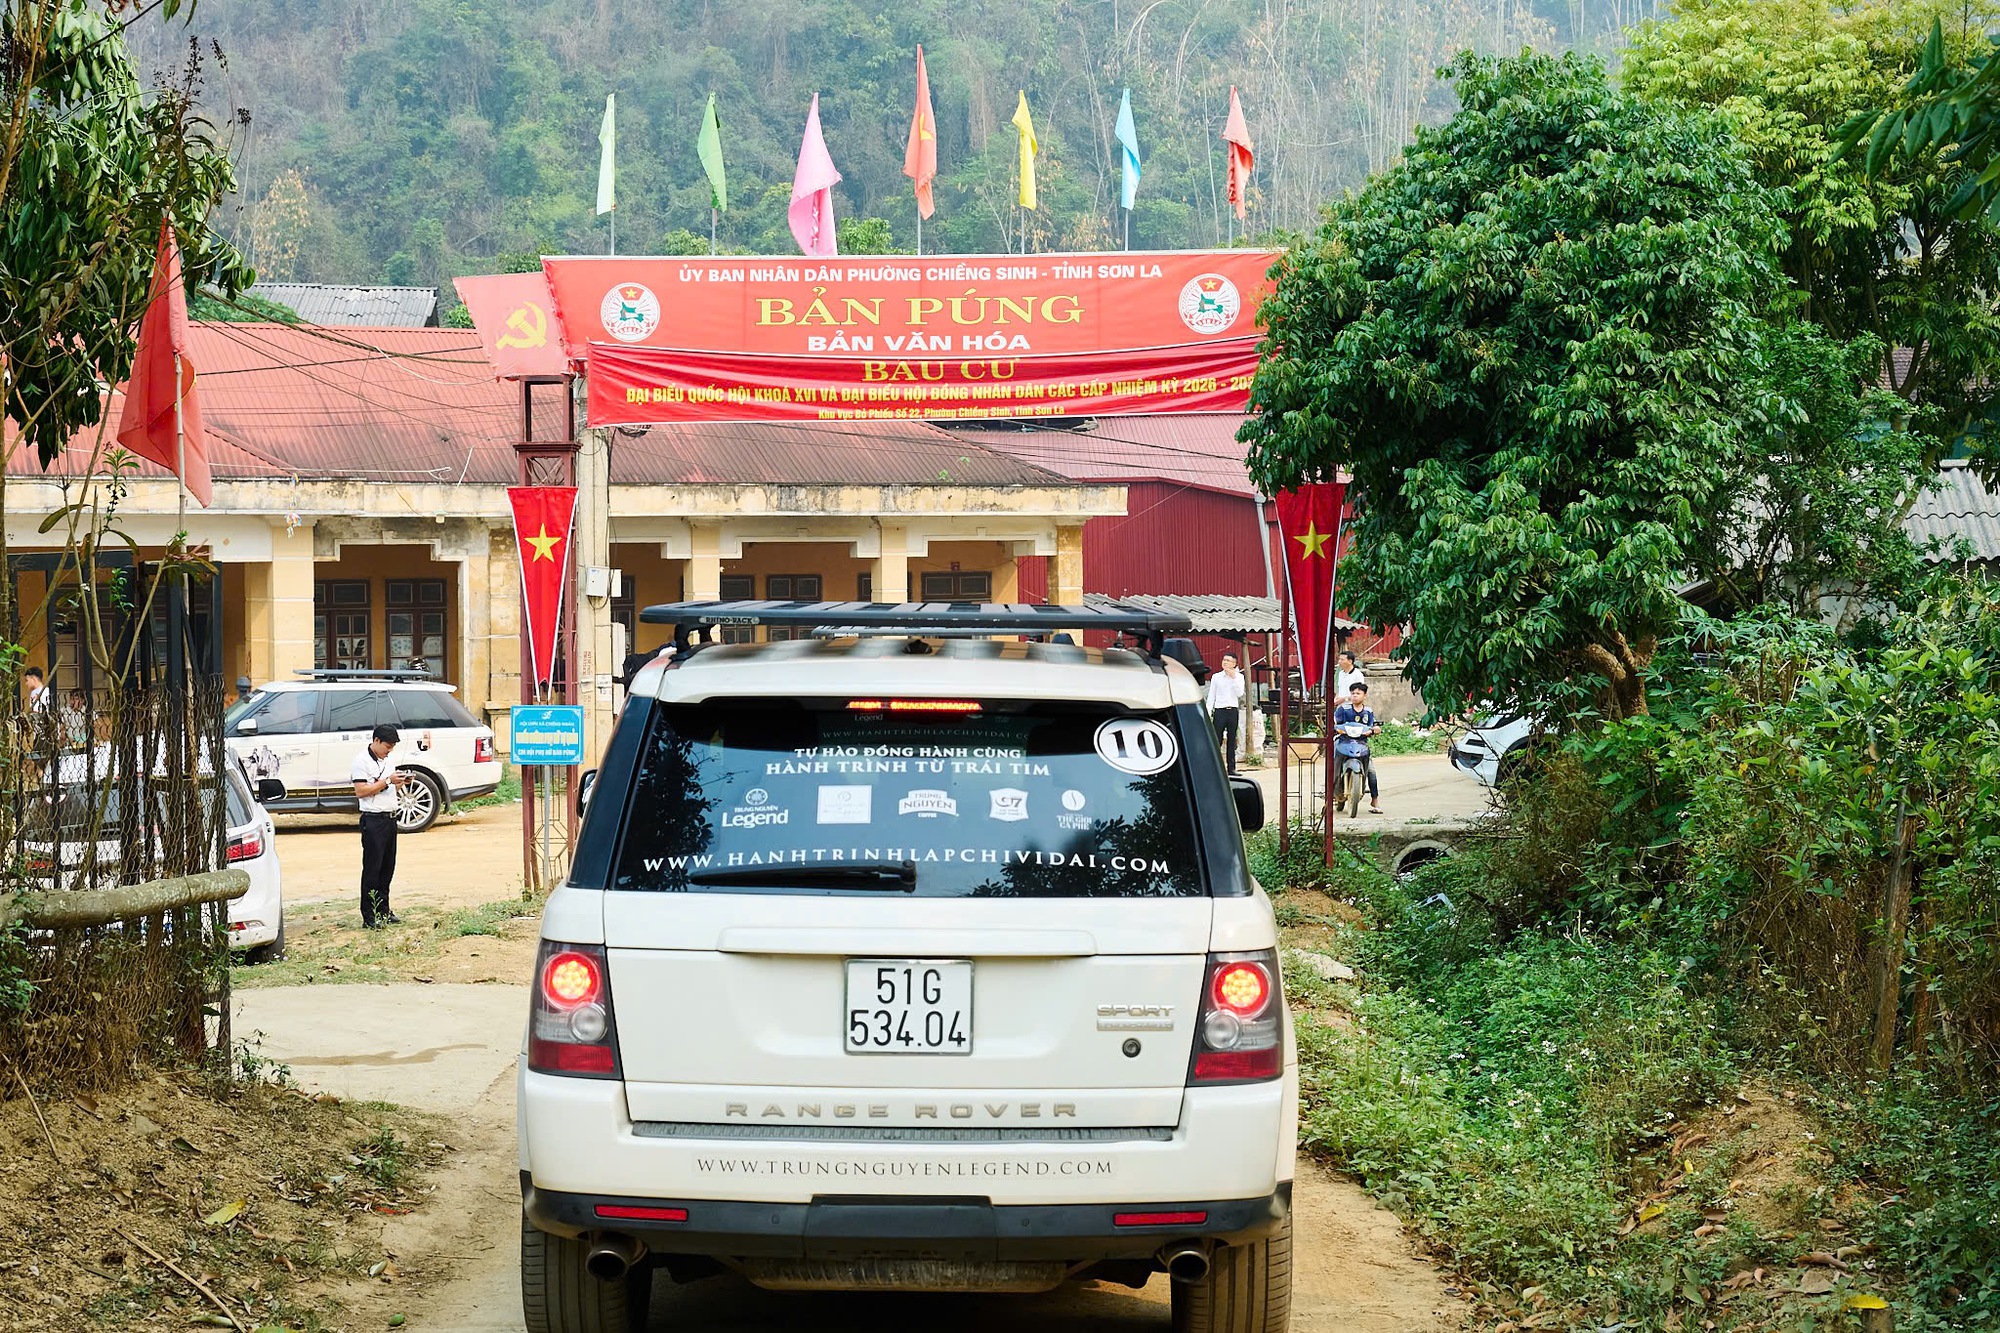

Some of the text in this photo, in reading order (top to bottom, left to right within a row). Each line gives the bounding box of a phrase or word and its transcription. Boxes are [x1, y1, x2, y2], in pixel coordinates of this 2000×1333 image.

[680, 264, 704, 282] ỦY
[709, 269, 744, 282] BAN
[750, 266, 798, 282] NHÂN
[804, 266, 842, 282] DÂN
[847, 265, 921, 282] PHƯỜNG
[926, 262, 991, 281] CHIỀNG
[996, 267, 1037, 281] SINH
[1051, 261, 1092, 279] TỈNH
[1097, 265, 1135, 278] SƠN
[1139, 265, 1163, 278] LA
[755, 286, 1086, 326] BẢN PÚNG
[808, 330, 1031, 351] BẢN VĂN HÓA
[626, 388, 649, 406] ĐẠI
[653, 383, 684, 403] BIỂU
[687, 383, 723, 404] QUỐC
[727, 386, 751, 405] HỘI
[794, 388, 817, 402] XVI
[820, 386, 838, 402] VÀ
[841, 388, 864, 405] ĐẠI
[868, 383, 900, 402] BIỂU
[904, 385, 927, 404] HỘI
[972, 383, 1011, 400] NHÂN
[1015, 382, 1044, 399] DÂN
[1047, 381, 1076, 398] CÁC
[1079, 378, 1108, 397] CẤP
[1111, 377, 1157, 397] NHIỆM
[1161, 377, 1178, 394] KỲ
[1182, 377, 1217, 393] 2026
[1230, 376, 1255, 391] 203
[908, 408, 922, 420] 22,
[1054, 406, 1065, 416] La
[794, 747, 820, 760] TỰ
[823, 745, 858, 758] HÀO
[919, 745, 967, 759] HÀNH
[973, 747, 1022, 760] CÙNG
[1109, 729, 1163, 760] 10
[766, 759, 1051, 777] HÀNH TRÌNH TỪ TRÁI TIM
[721, 809, 789, 829] Legend
[643, 848, 1170, 874] WWW.HANHTRINHLAPCHIVIDAI.COM
[877, 968, 941, 1005] 51G
[1097, 1004, 1175, 1017] SPORT
[850, 1009, 967, 1048] 534.04
[725, 1102, 1077, 1119] RANGE ROVER
[697, 1158, 1113, 1177] WWW.TRUNGNGUYENLEGEND.COM
